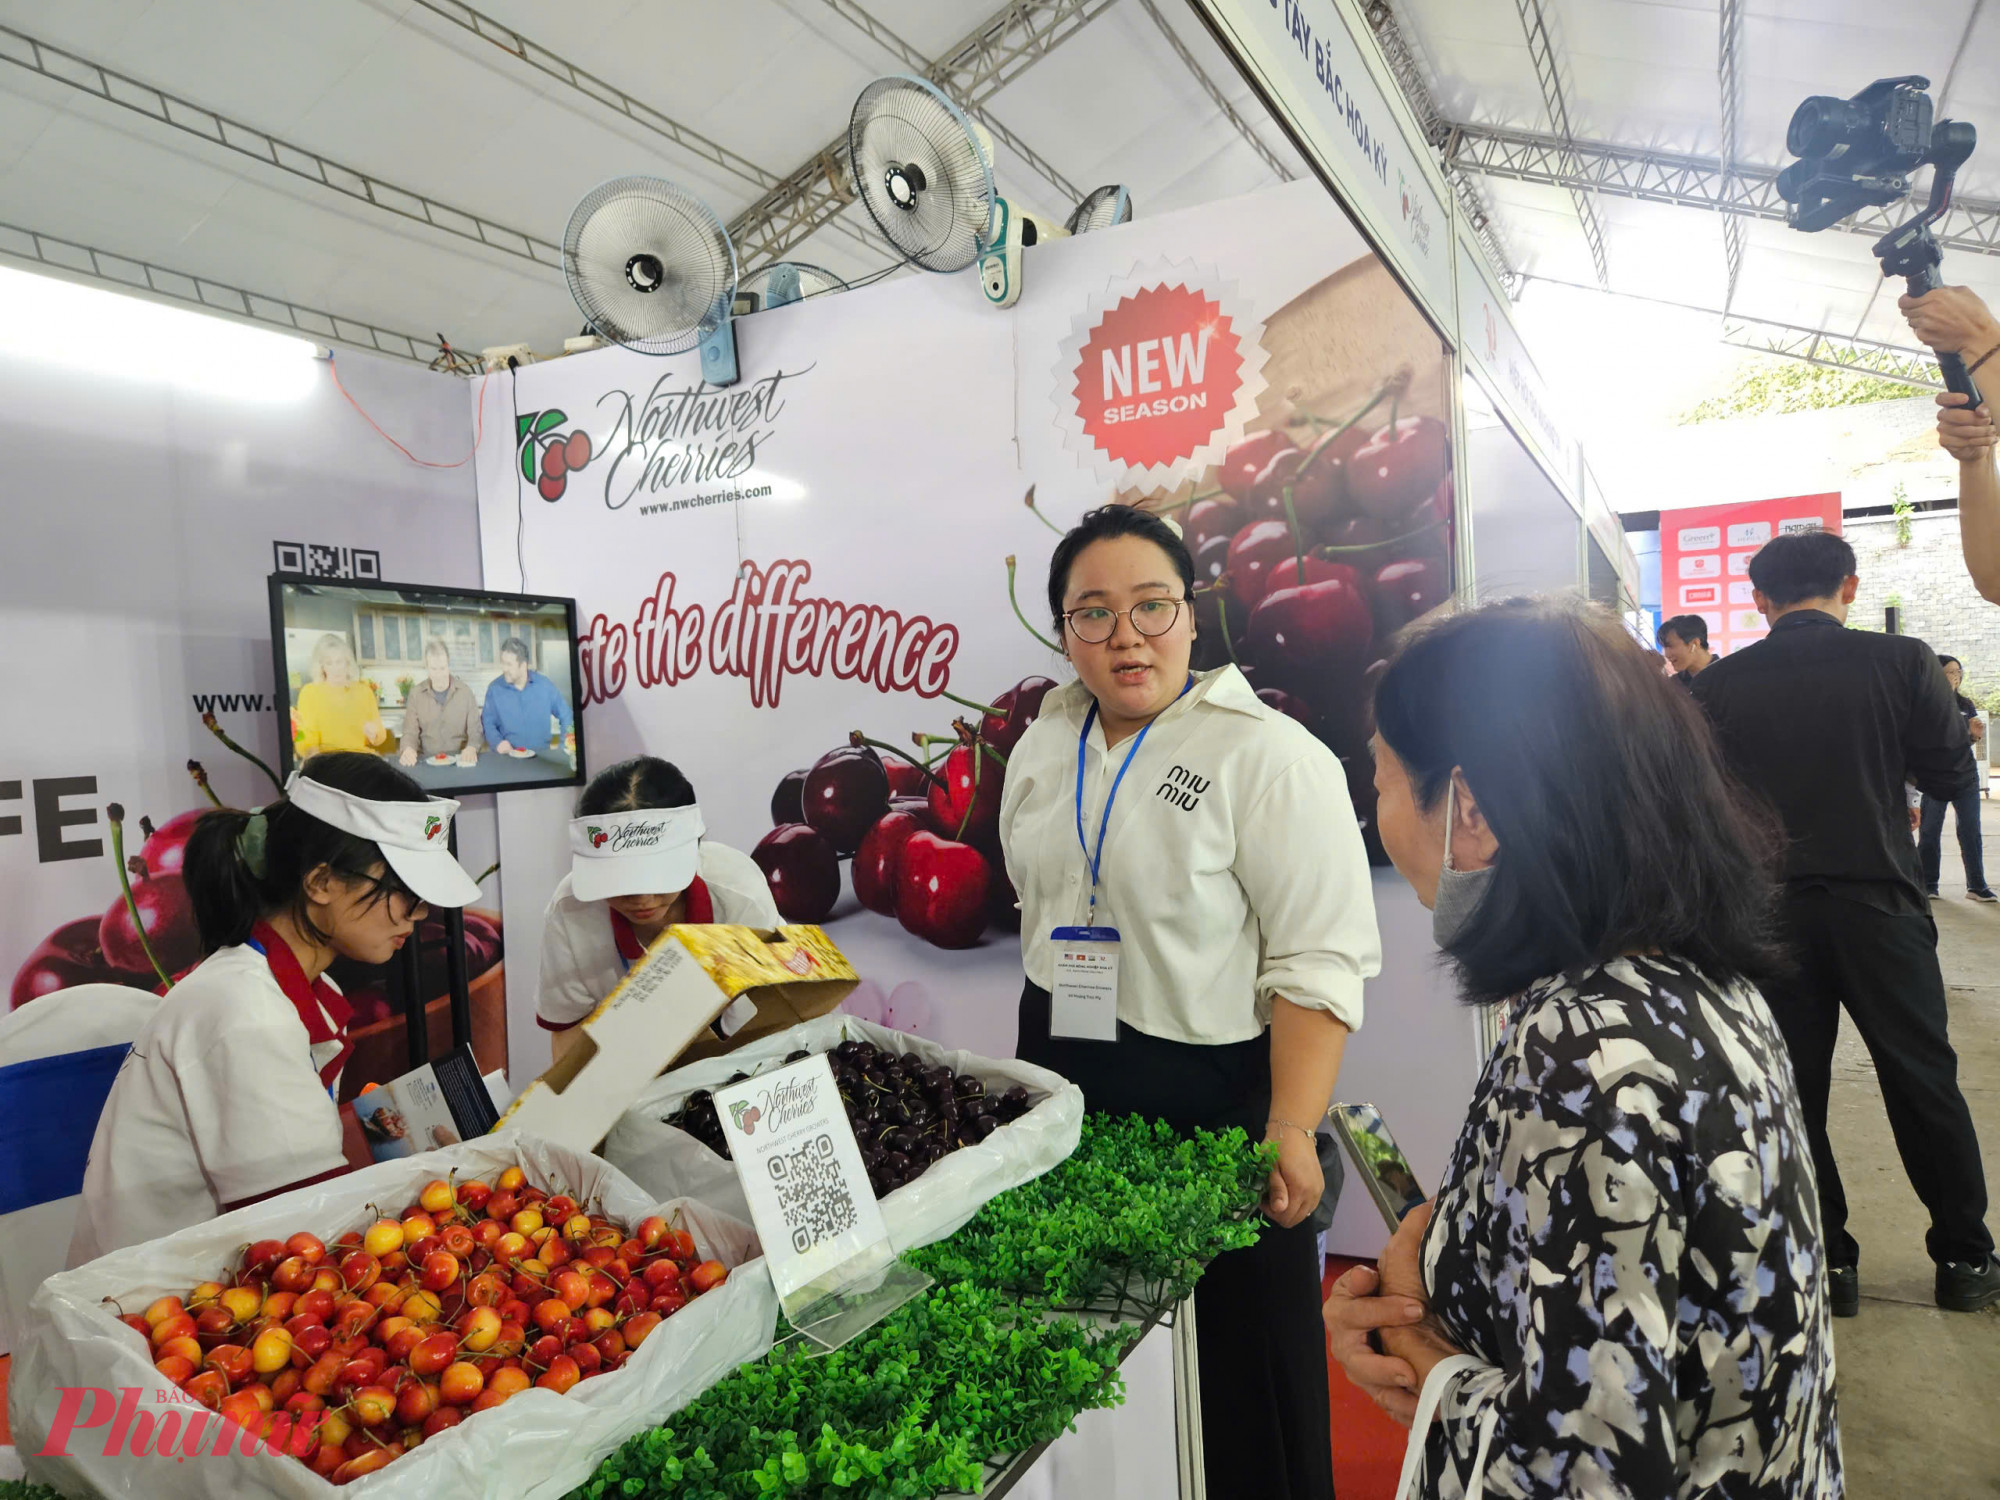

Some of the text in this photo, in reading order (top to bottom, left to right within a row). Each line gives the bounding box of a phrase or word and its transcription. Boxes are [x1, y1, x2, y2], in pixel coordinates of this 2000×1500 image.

[1315, 38, 1343, 116] BẮC
[1346, 90, 1371, 163] HOA
[1374, 138, 1387, 187] KỲ
[1102, 330, 1210, 401] NEW
[590, 361, 817, 461] Northwest
[1103, 392, 1208, 425] SEASON
[605, 430, 775, 510] Cherries
[639, 484, 773, 516] www.nwcherries.com
[632, 571, 704, 689] the
[708, 558, 959, 709] difference
[608, 819, 672, 841] Northwest
[612, 834, 664, 852] Cherries
[757, 1073, 823, 1117] Northwest
[768, 1095, 819, 1133] Cherries
[756, 1118, 830, 1154] NORTHWEST CHERRY GROWERS
